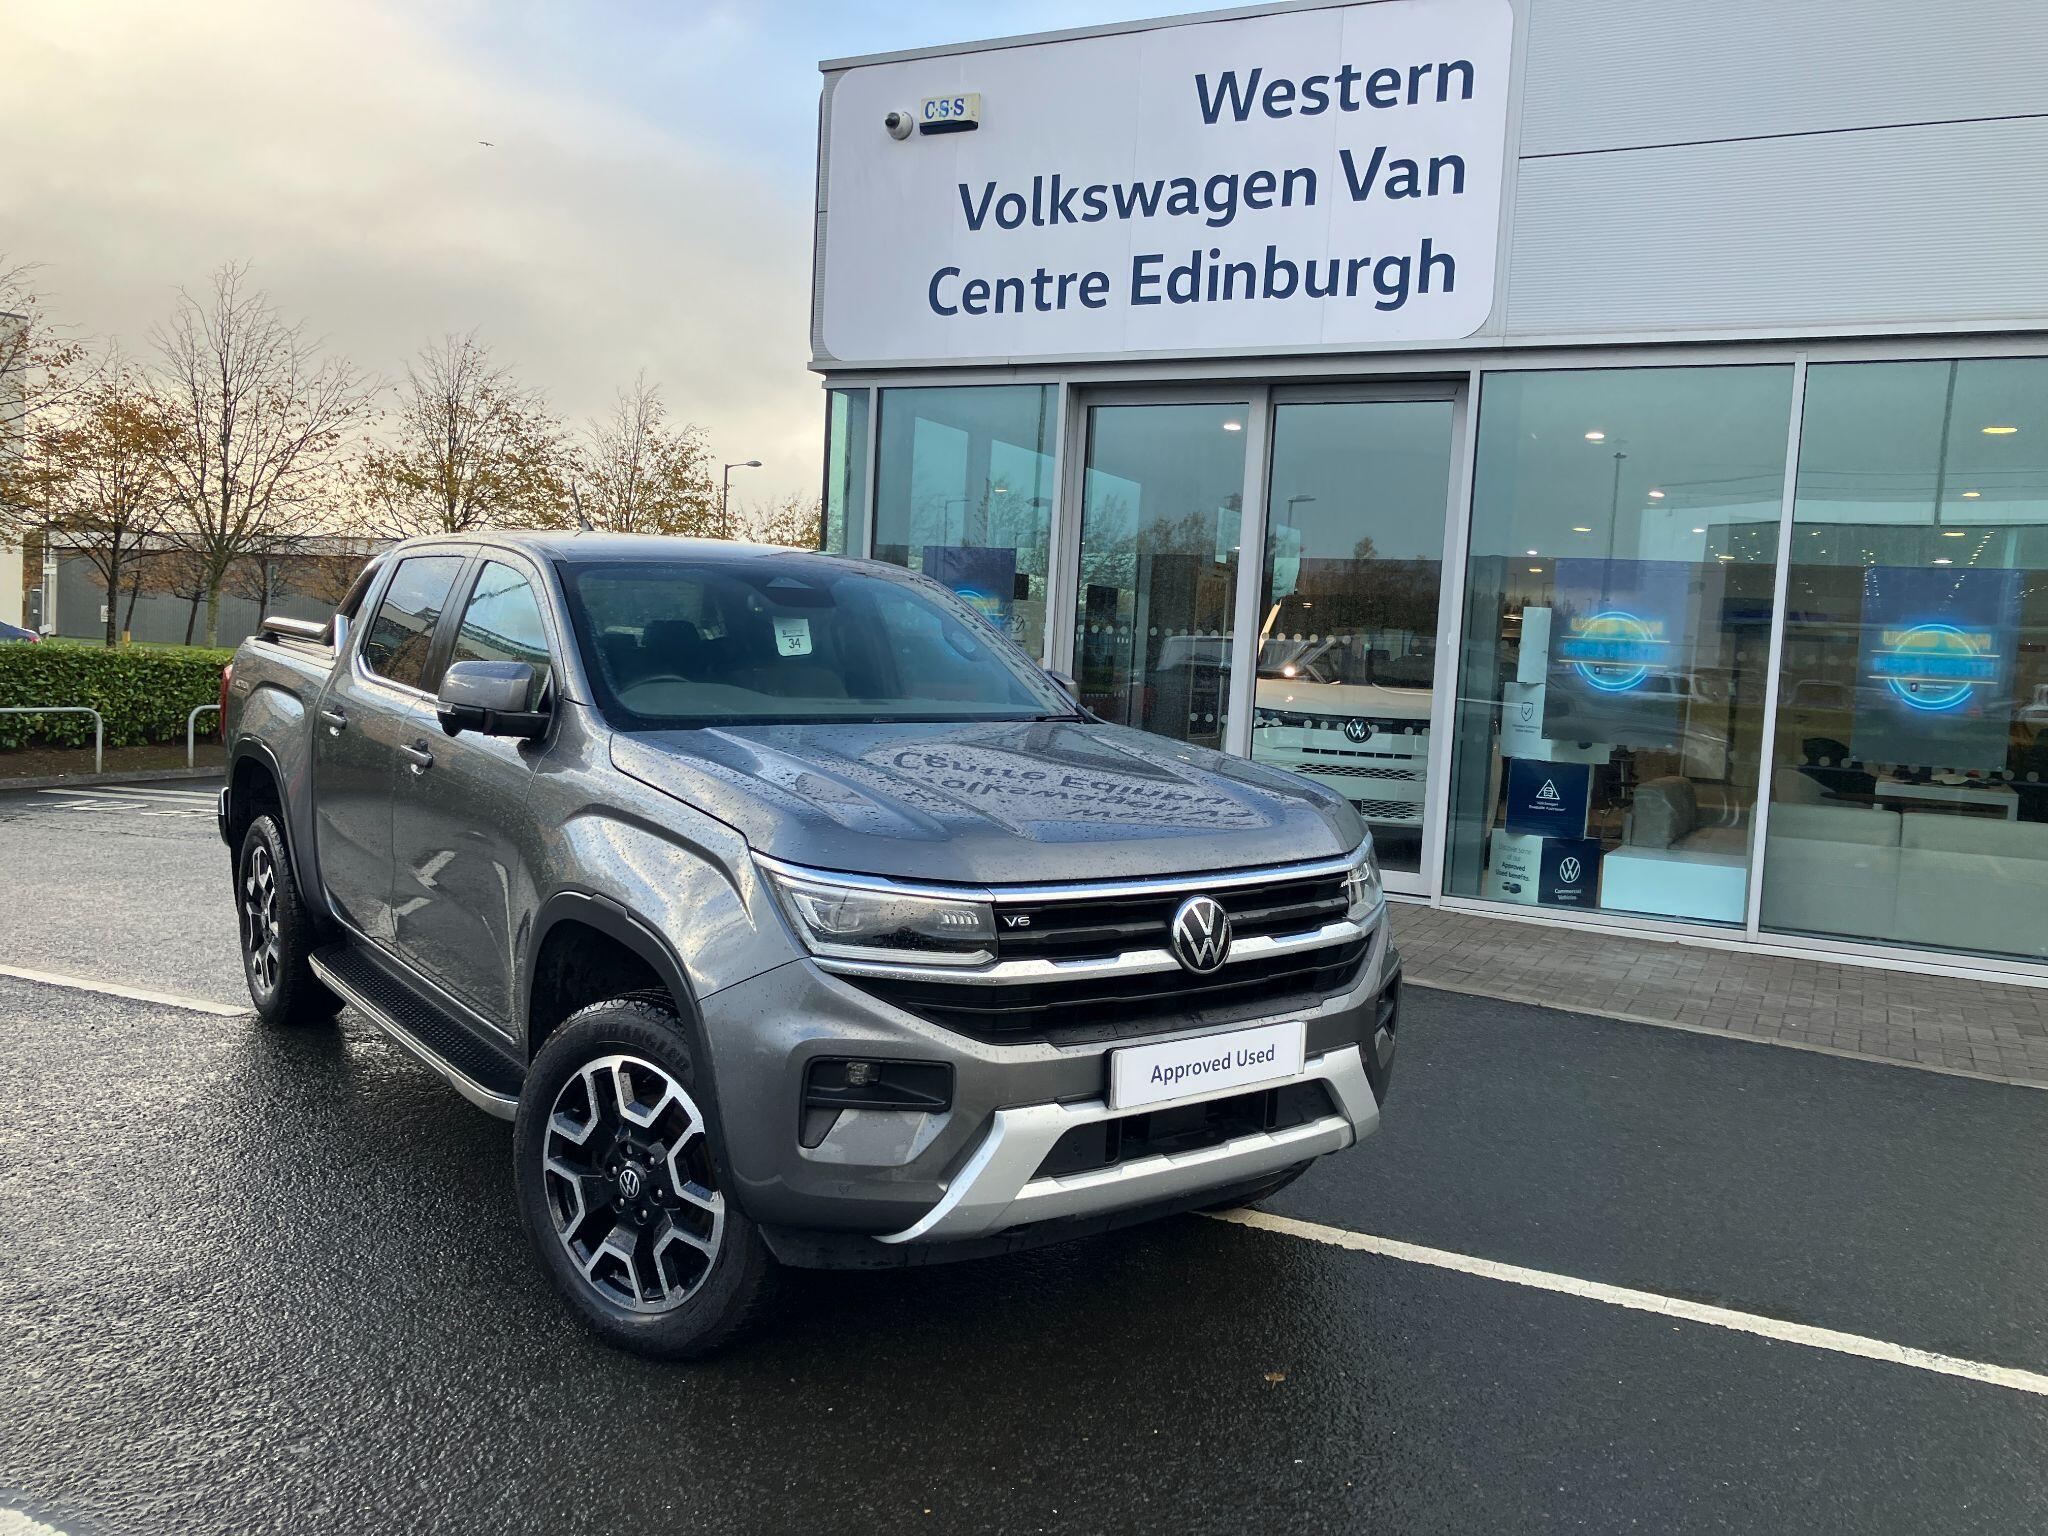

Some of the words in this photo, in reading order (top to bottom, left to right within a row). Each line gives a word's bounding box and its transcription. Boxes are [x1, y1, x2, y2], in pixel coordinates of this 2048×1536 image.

[1194, 59, 1475, 125] Western
[958, 166, 1318, 231] Volkswagen
[1338, 145, 1466, 202] Van
[928, 266, 1110, 317] Centre
[1130, 238, 1456, 311] Edinburgh
[788, 637, 801, 649] 34
[1501, 861, 1526, 872] Approved
[1003, 915, 1031, 928] V6
[1150, 1051, 1231, 1086] Approved
[1236, 1043, 1275, 1067] Used
